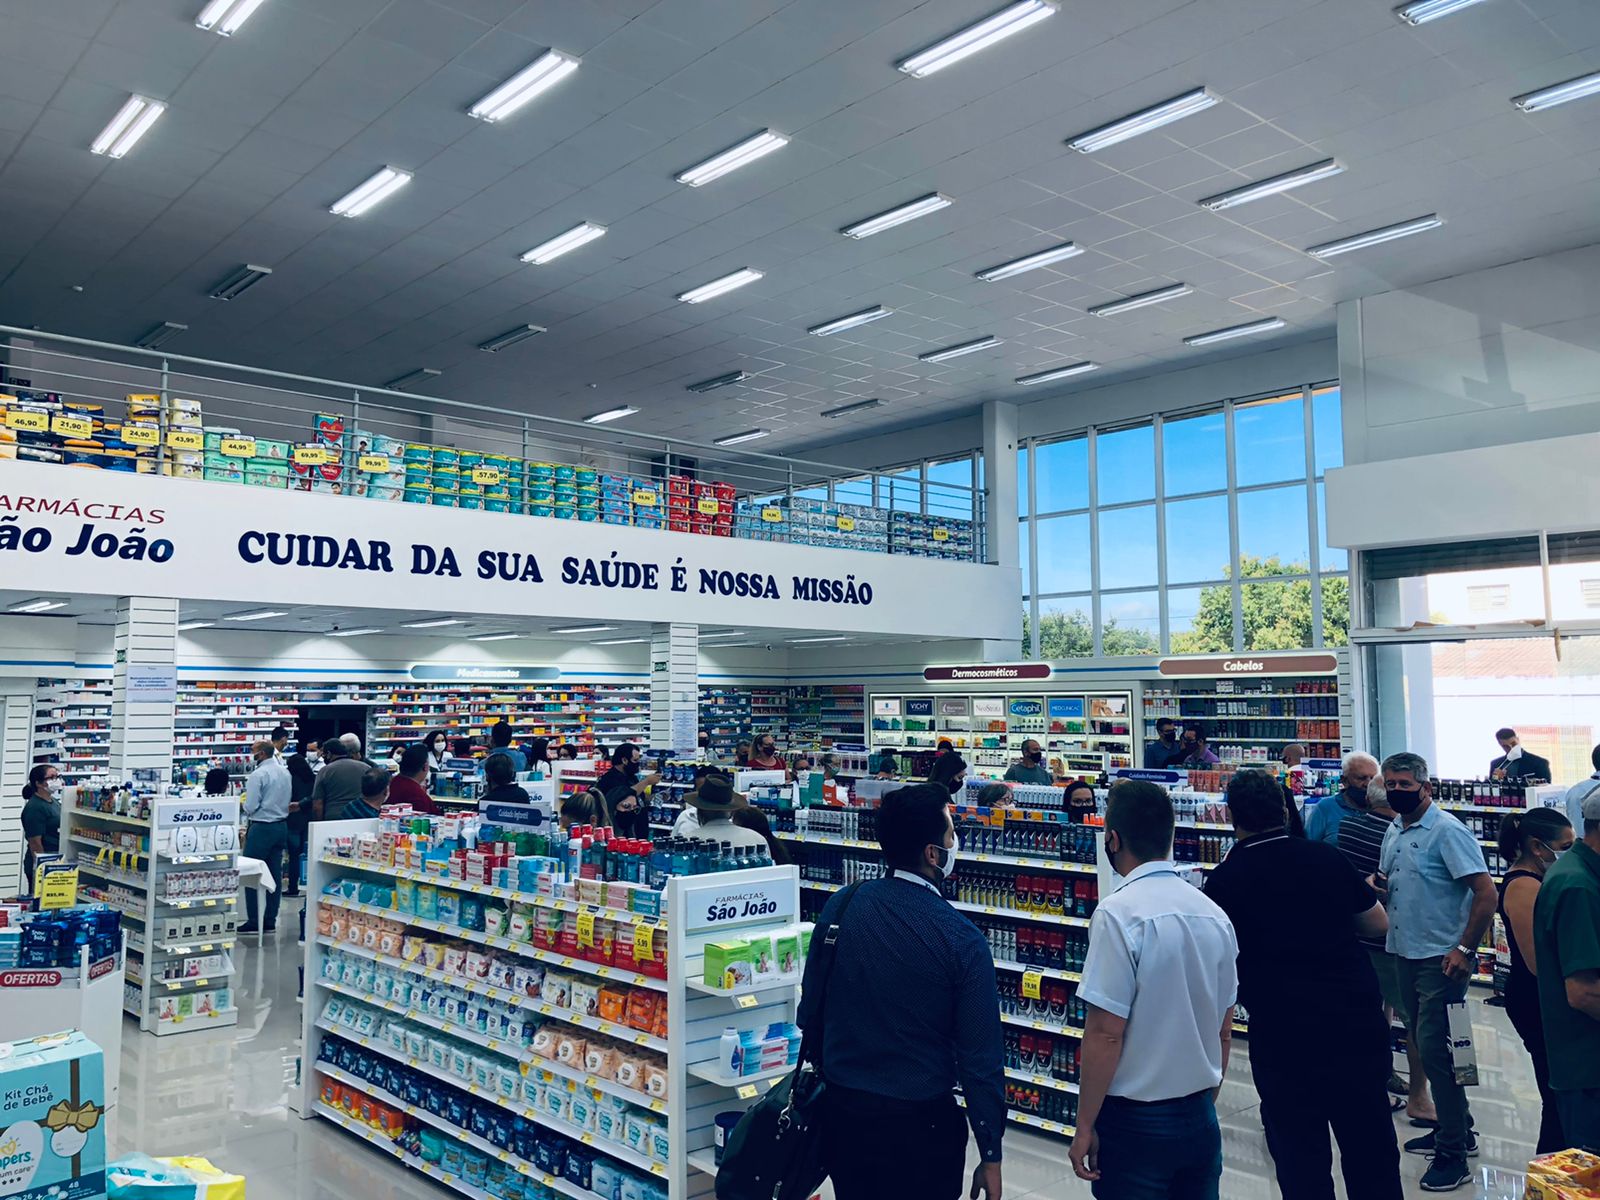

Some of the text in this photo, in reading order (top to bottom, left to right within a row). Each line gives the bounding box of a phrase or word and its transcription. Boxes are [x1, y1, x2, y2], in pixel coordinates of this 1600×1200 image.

[14, 418, 38, 427] 46,90
[60, 421, 82, 430] 21,90
[129, 430, 150, 438] 24,90
[174, 436, 195, 444] 43,99
[228, 443, 247, 451] 44,99
[476, 472, 498, 480] 57,90
[0, 494, 165, 524] ARMÁCIAS
[0, 515, 174, 563] ão João
[238, 530, 874, 606] CUIDAR DA SUA SAÚDE É NOSSA MISSÃO
[1223, 660, 1264, 672] Cabelos
[456, 668, 521, 679] Medicamentos
[951, 667, 1018, 678] Dermocosméticos
[1011, 703, 1041, 714] Cetaphil
[172, 811, 223, 823] São João
[715, 892, 765, 904] FARMÁCIAS
[706, 898, 777, 922] São João
[4, 973, 57, 985] OFERTAS
[5, 1083, 49, 1101] Kit Chá
[3, 1091, 54, 1110] de Bebê
[0, 1150, 31, 1170] pers
